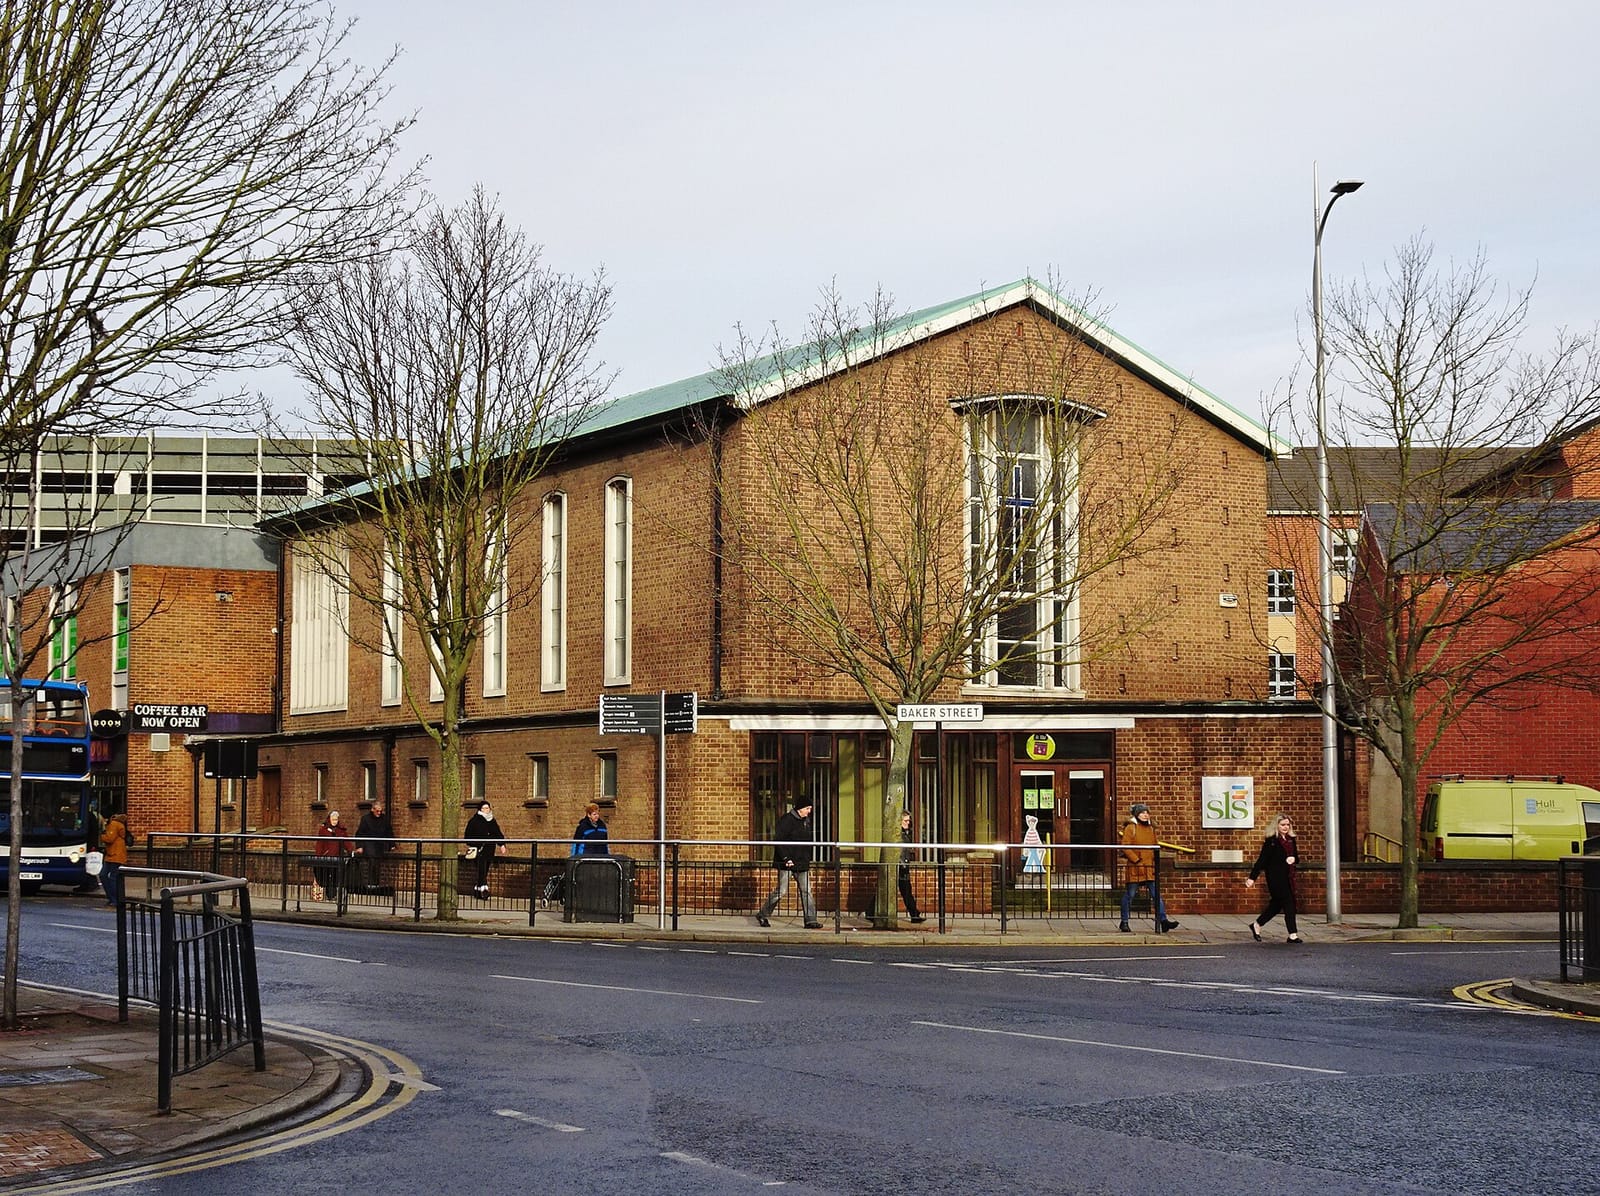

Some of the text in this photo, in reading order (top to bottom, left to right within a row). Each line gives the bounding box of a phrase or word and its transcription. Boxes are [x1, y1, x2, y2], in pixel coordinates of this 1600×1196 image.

[134, 705, 206, 717] COFFEE BAR
[901, 708, 979, 718] BAKER STREET
[93, 719, 121, 728] BOOM
[141, 717, 200, 728] NOW OPEN
[1206, 791, 1249, 820] sls
[1535, 799, 1555, 808] Hull
